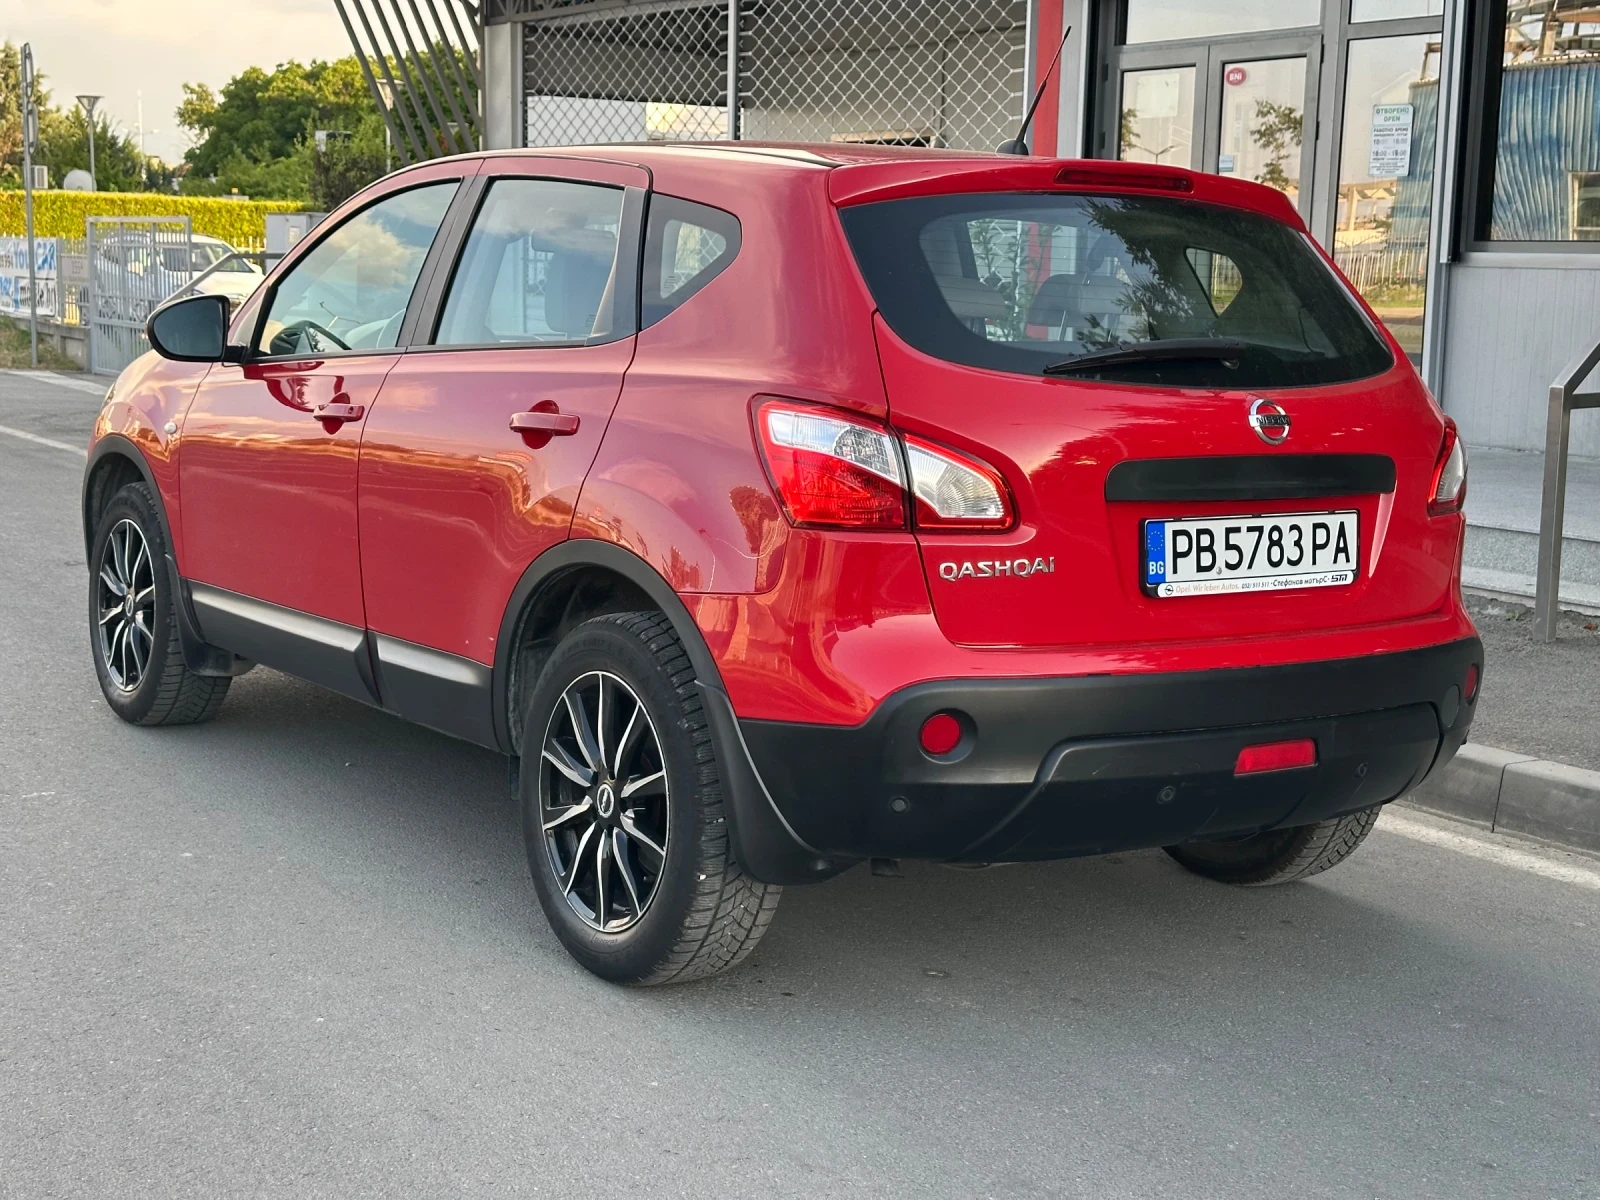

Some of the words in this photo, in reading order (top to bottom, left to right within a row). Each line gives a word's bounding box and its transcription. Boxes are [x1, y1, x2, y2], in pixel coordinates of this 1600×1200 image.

[1171, 527, 1217, 575] PB
[1224, 523, 1304, 571] 5783
[1311, 521, 1351, 566] PA
[939, 557, 1055, 582] QASHQAI
[1149, 561, 1165, 576] BG
